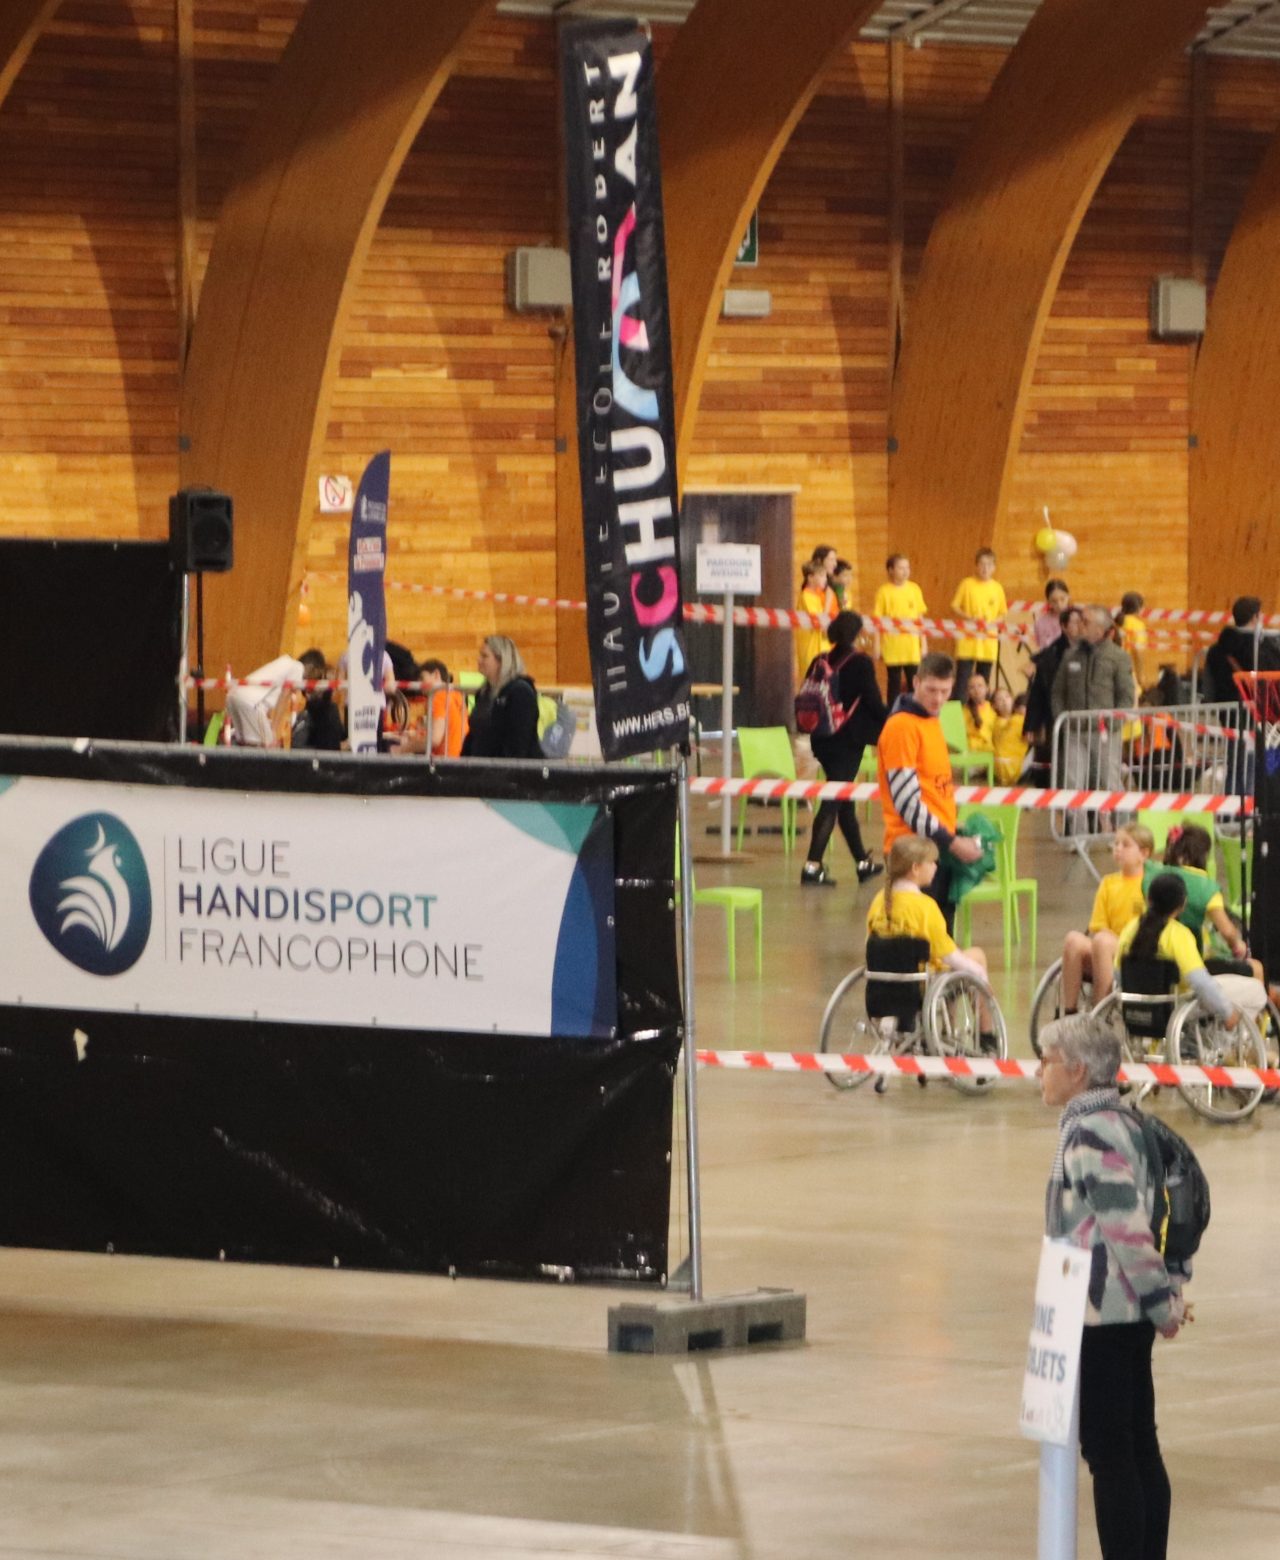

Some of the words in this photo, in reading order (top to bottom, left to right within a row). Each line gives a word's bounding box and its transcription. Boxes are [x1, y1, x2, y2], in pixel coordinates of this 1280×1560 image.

[584, 61, 612, 281] ROBERT
[178, 836, 291, 879] LIGUE
[178, 880, 438, 930] HANDISPORT
[179, 927, 485, 983] FRANCOPHONE
